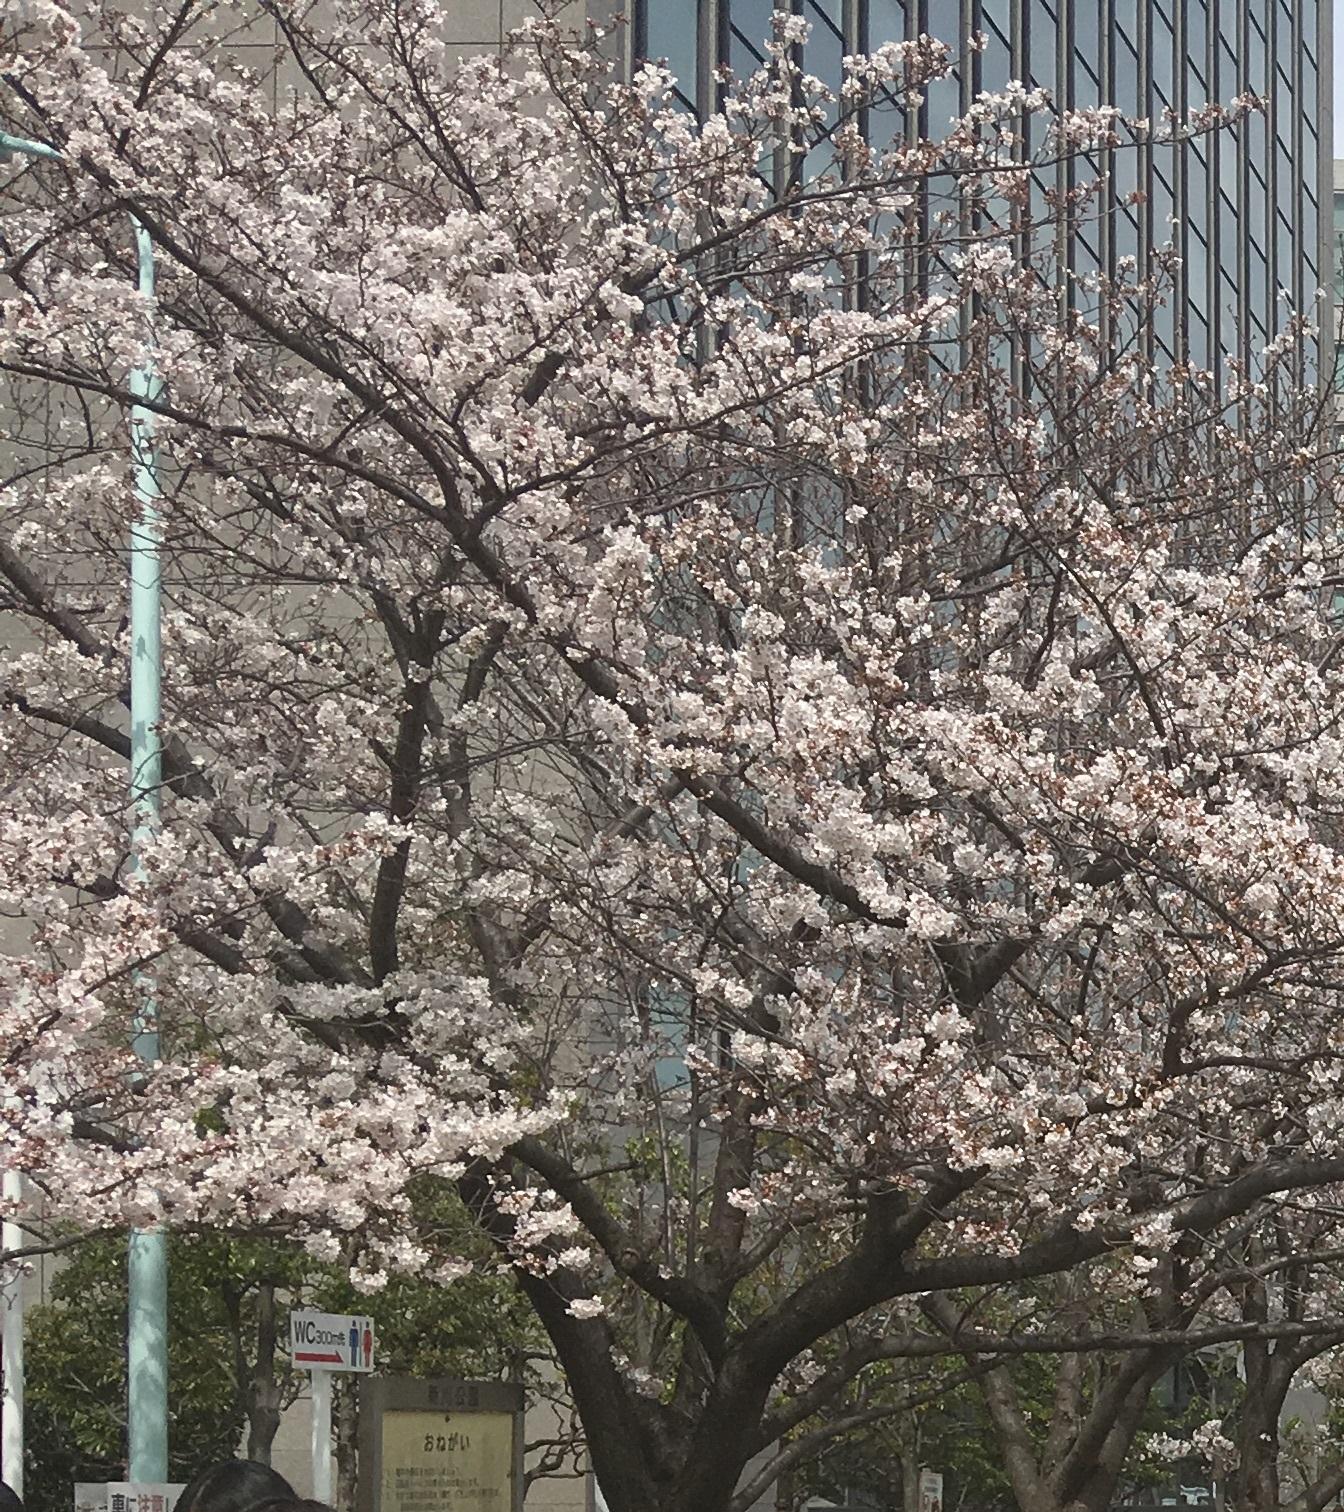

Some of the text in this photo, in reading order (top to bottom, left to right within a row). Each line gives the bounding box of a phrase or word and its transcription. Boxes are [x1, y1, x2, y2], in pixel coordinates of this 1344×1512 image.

[294, 1320, 316, 1345] WC
[423, 1431, 471, 1452] おねがい
